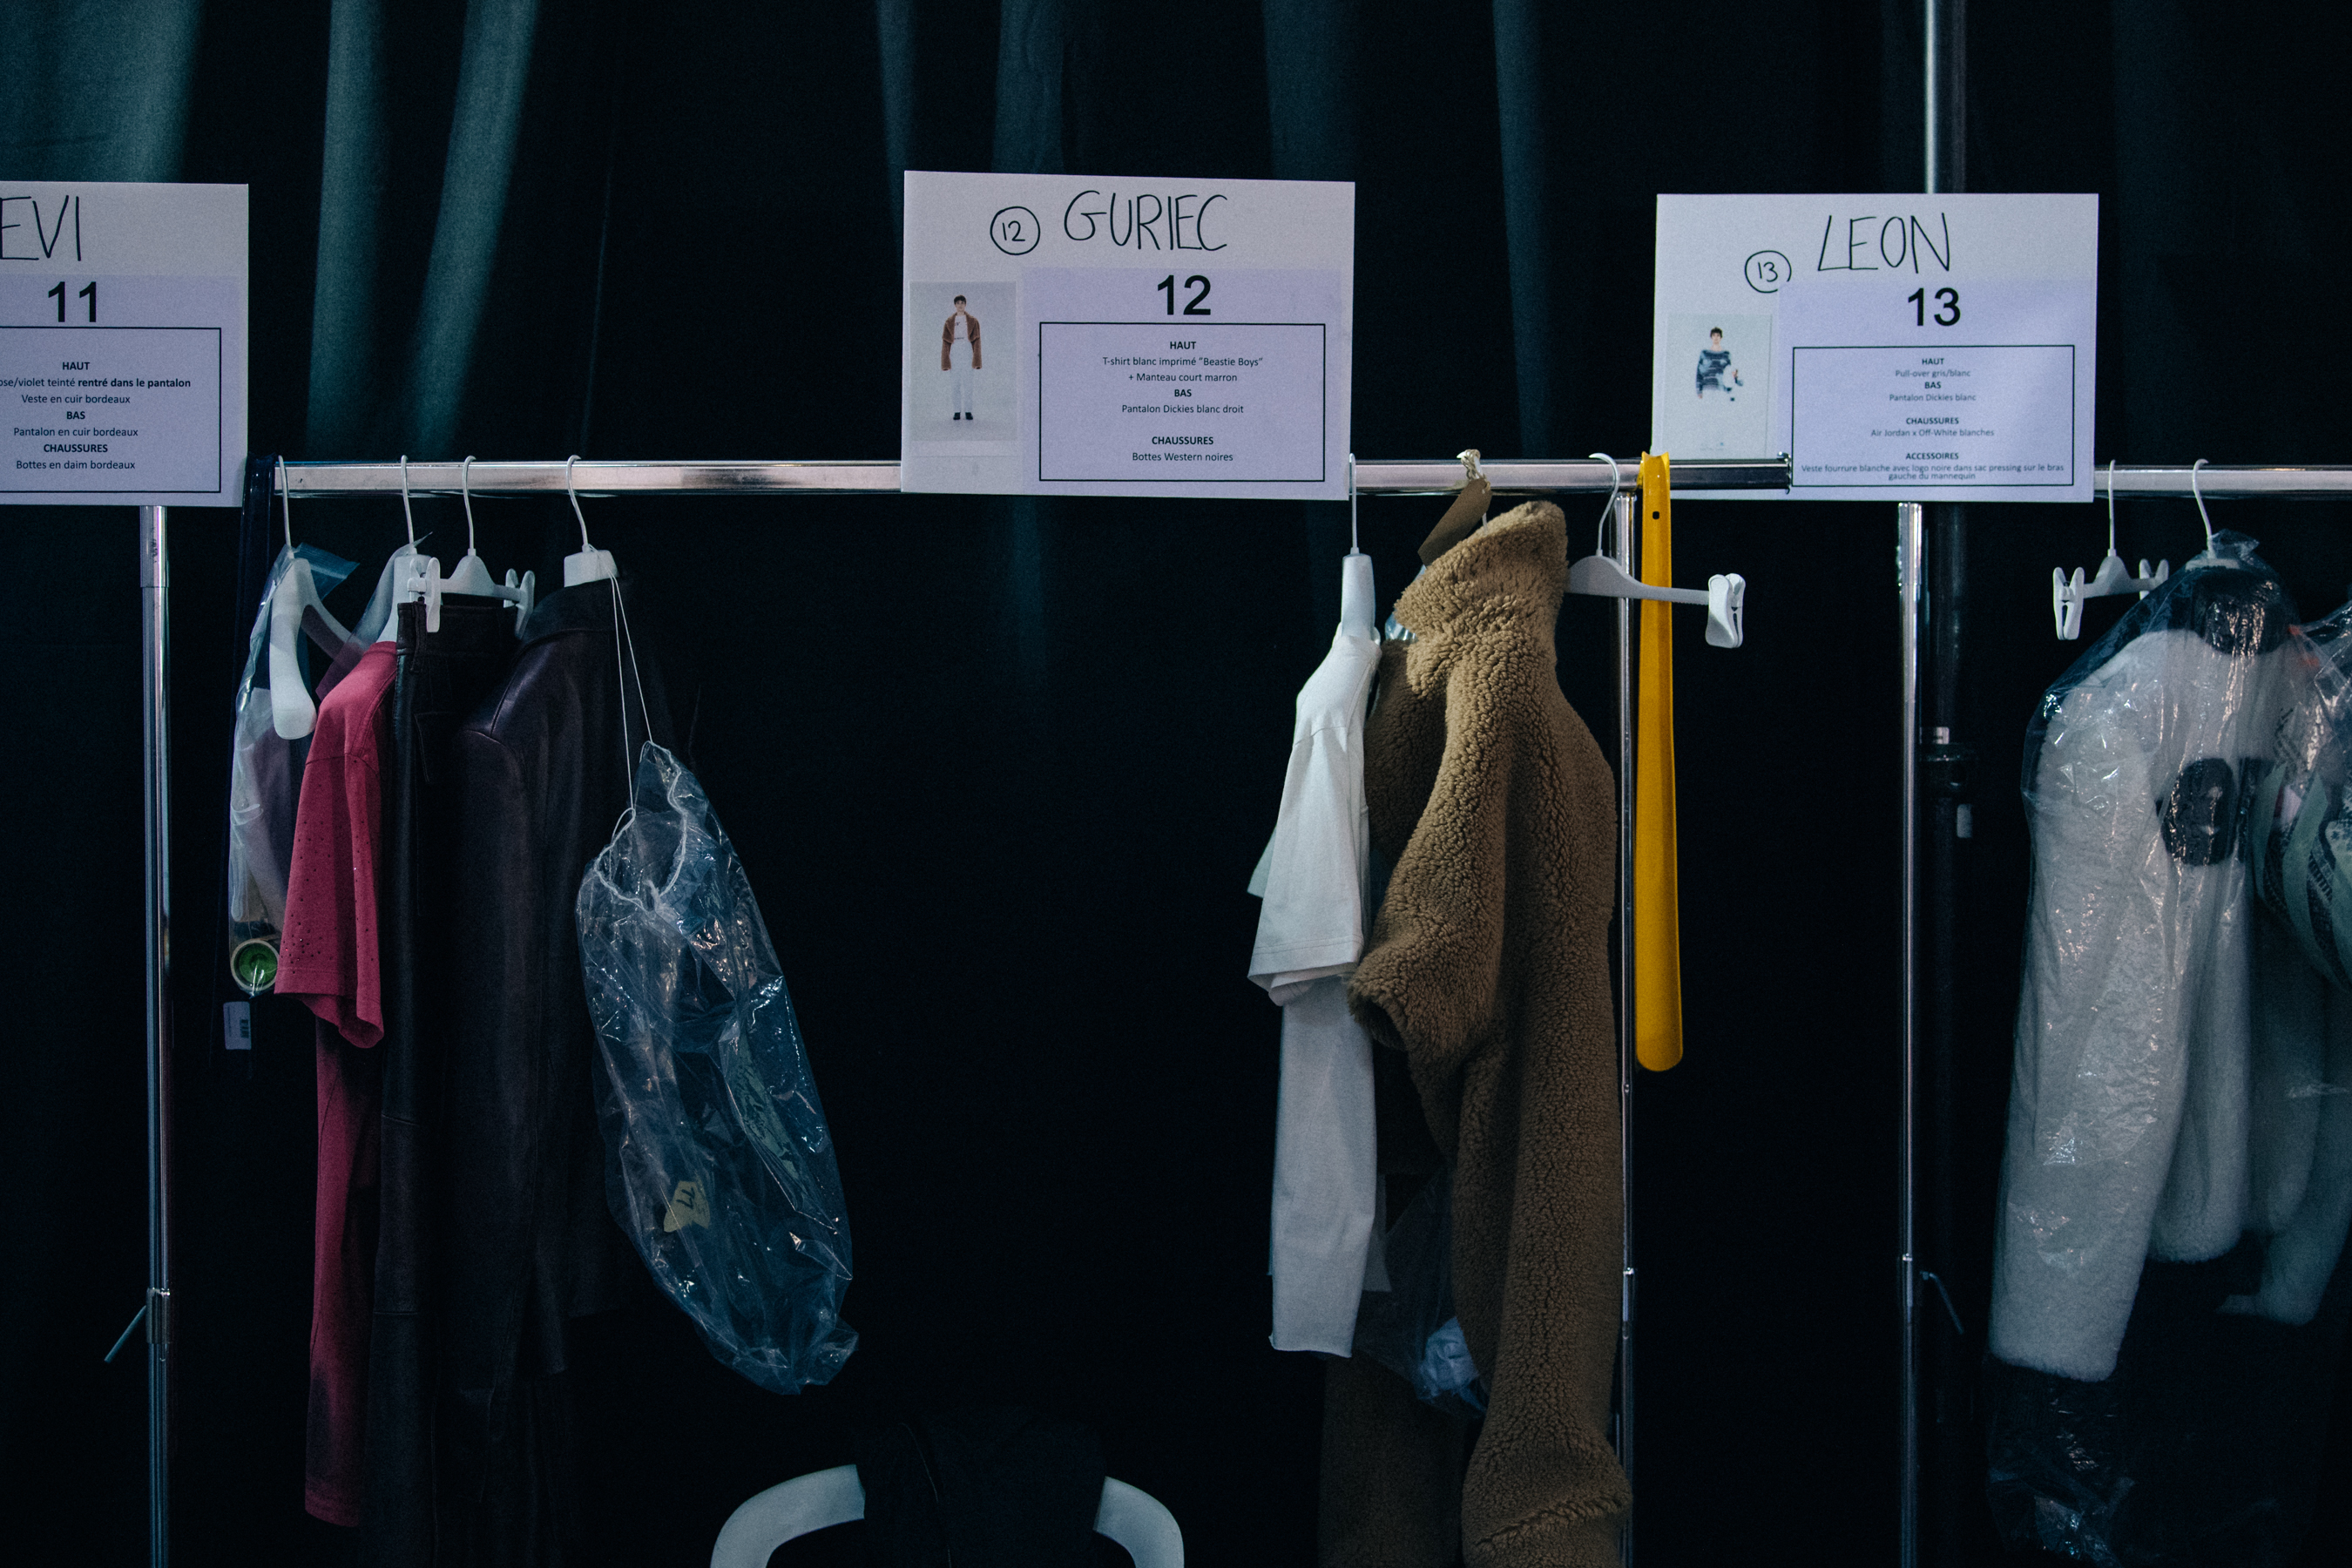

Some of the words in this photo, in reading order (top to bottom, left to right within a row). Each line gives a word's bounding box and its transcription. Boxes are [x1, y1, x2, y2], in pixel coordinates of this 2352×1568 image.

[1002, 220, 1026, 242] 12
[1064, 190, 1228, 251] GURIEC
[0, 194, 82, 261] EVI
[1817, 212, 1950, 274] LEON
[1757, 260, 1779, 283] 13
[1157, 274, 1212, 315] 12
[47, 280, 98, 323] 11
[1907, 287, 1962, 327] 13
[1169, 341, 1197, 350] HAUT
[62, 361, 91, 371] HAUT
[1102, 356, 1131, 366] T-shirt
[1132, 356, 1157, 366] blanc
[1159, 356, 1197, 368] imprimé
[1921, 357, 1945, 366] HAUT
[1136, 372, 1177, 382] Manteau
[1178, 373, 1203, 382] court
[1895, 368, 1930, 378] Pull-over
[1931, 368, 1970, 379] gris/blanc
[47, 378, 76, 388] teinté
[78, 377, 109, 388] rentré
[110, 377, 134, 388] dans
[135, 377, 145, 388] le
[146, 377, 192, 389] pantalon
[1923, 381, 1942, 389] BAS
[21, 394, 48, 404] Veste
[50, 395, 63, 404] en
[64, 394, 84, 404] cuir
[84, 394, 131, 404] bordeaux
[1173, 389, 1193, 398] BAS
[1889, 393, 1924, 402] Pantalon
[1925, 393, 1954, 402] Dickies
[1954, 393, 1977, 402] blanc
[1121, 403, 1161, 414] Pantalon
[1162, 404, 1195, 414] Dickies
[1196, 404, 1220, 414] blanc
[1222, 404, 1244, 414] droit
[65, 410, 86, 421] BAS
[1905, 416, 1960, 425] CHAUSSURES
[13, 426, 56, 436] Pantalon
[71, 427, 91, 436] cuir
[92, 427, 139, 437] bordeaux
[1870, 429, 1882, 437] Air
[1883, 429, 1911, 437] Jordan
[1918, 429, 1958, 437] Off-White
[1958, 428, 1995, 437] blanches
[1151, 436, 1214, 446] CHAUSSURES
[43, 443, 109, 454] CHAUSSURES
[1132, 451, 1162, 462] Bottes
[1163, 452, 1203, 462] Western
[1205, 452, 1234, 462] noires
[1905, 451, 1959, 461] ACCESSOIRES
[16, 459, 47, 470] Bottes
[63, 460, 88, 470] daim
[90, 459, 136, 470] bordeaux
[1912, 464, 1930, 474] logo
[1889, 472, 1916, 481] gauche
